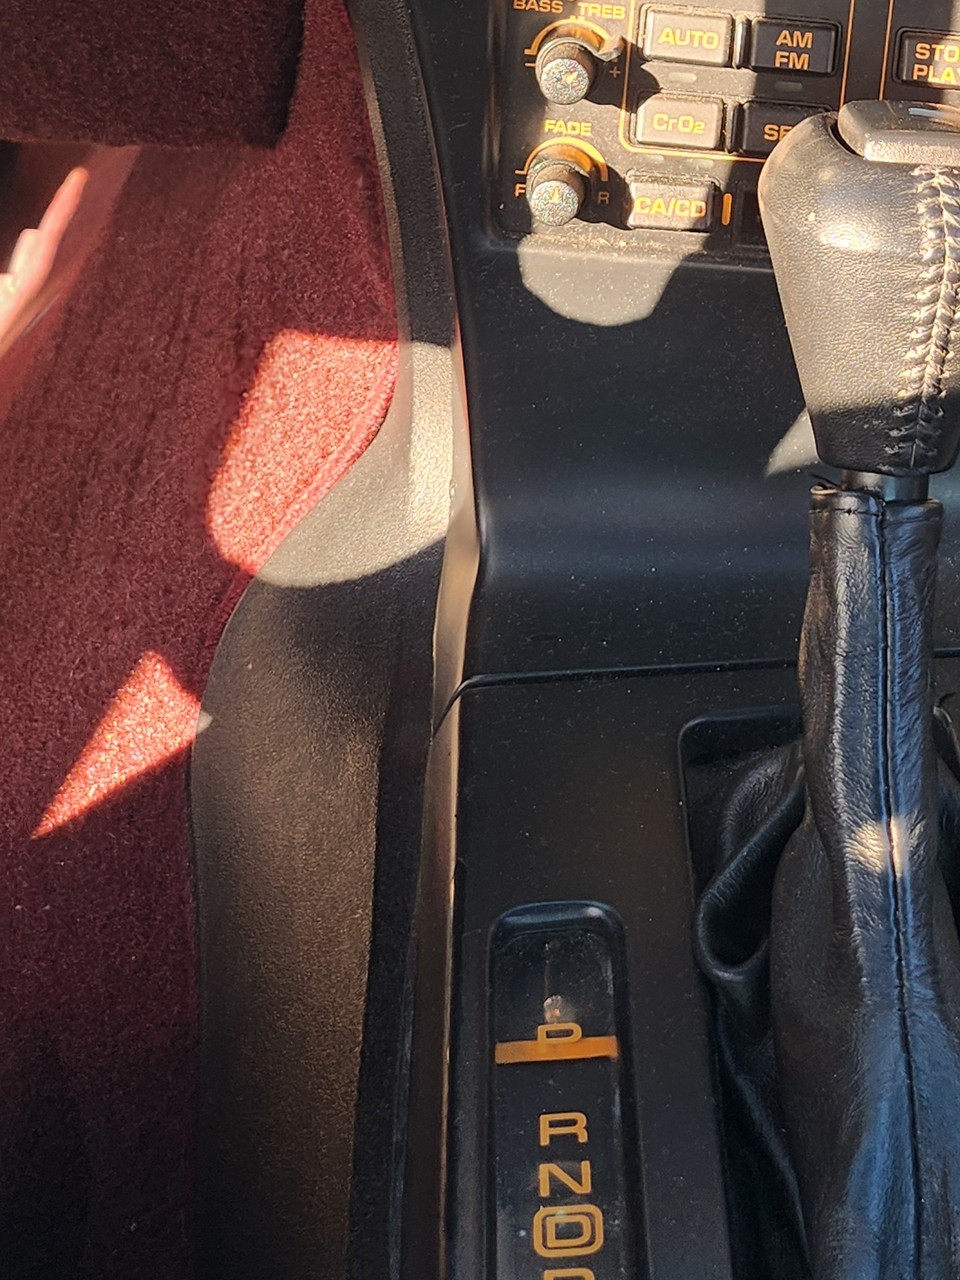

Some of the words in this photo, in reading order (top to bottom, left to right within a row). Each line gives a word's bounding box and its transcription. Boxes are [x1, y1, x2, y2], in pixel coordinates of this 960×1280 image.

[577, 2, 627, 19] TREB
[658, 28, 719, 50] AUTO
[775, 29, 814, 49] AM
[774, 51, 810, 71] FM
[544, 119, 593, 137] FADE
[635, 196, 707, 218] CA/CD
[539, 1111, 589, 1147] R
[538, 1159, 592, 1198] N
